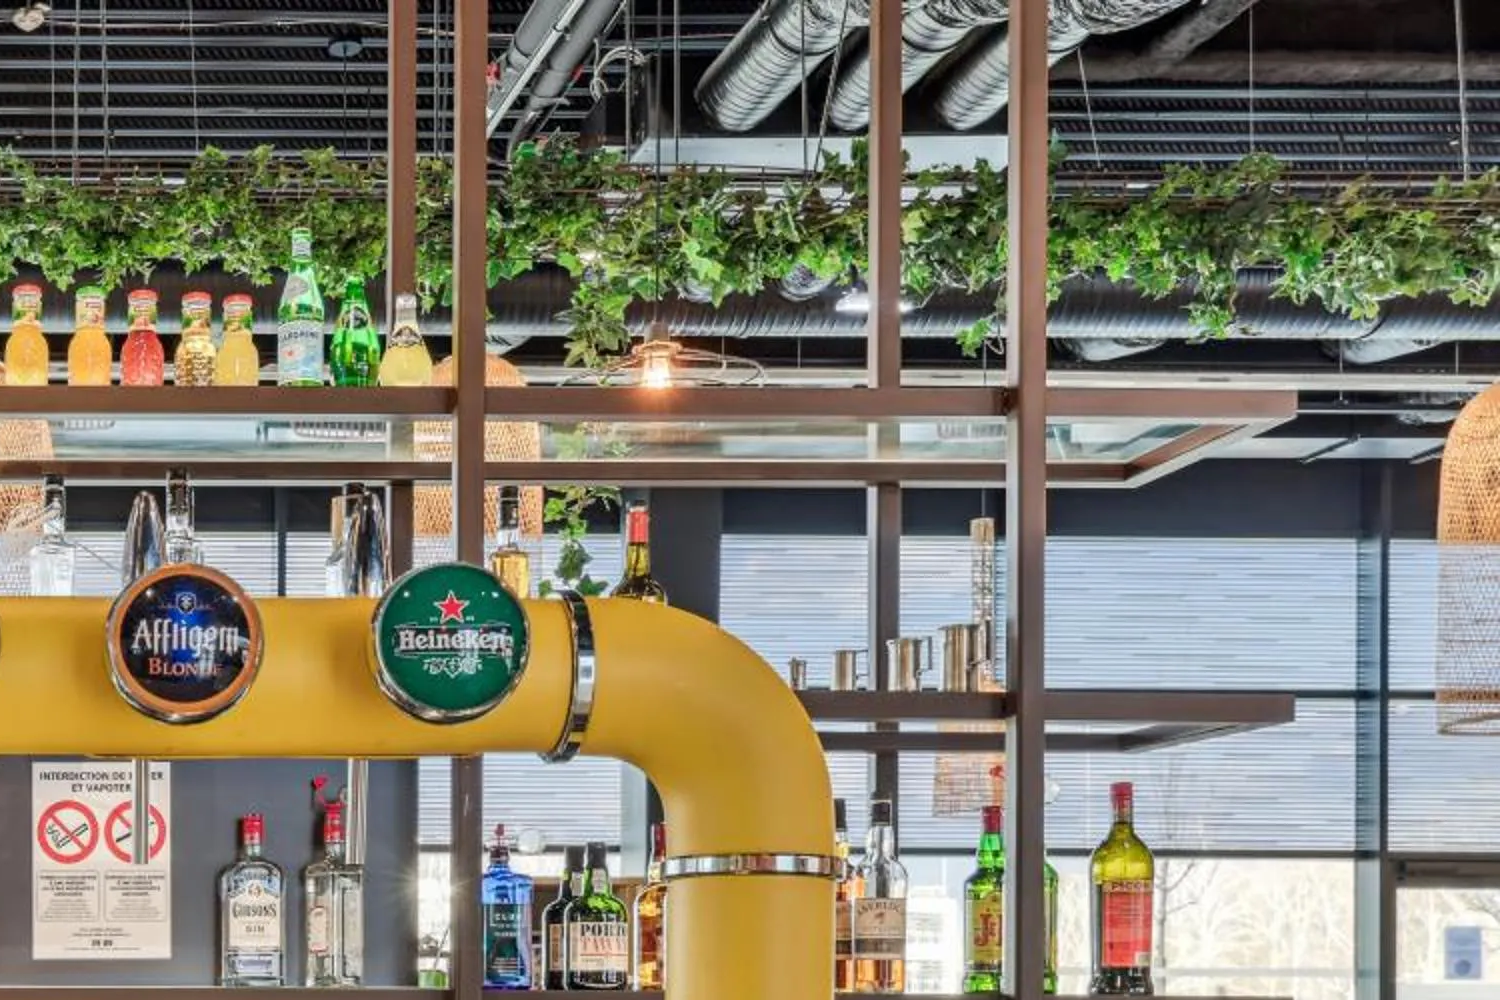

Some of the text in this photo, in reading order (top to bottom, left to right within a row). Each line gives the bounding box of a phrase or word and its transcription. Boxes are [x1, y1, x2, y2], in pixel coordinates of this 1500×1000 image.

[130, 618, 240, 658] Affligem
[399, 626, 508, 652] Heineken
[39, 771, 109, 781] INTERDICTION
[85, 783, 132, 793] VAPOTER
